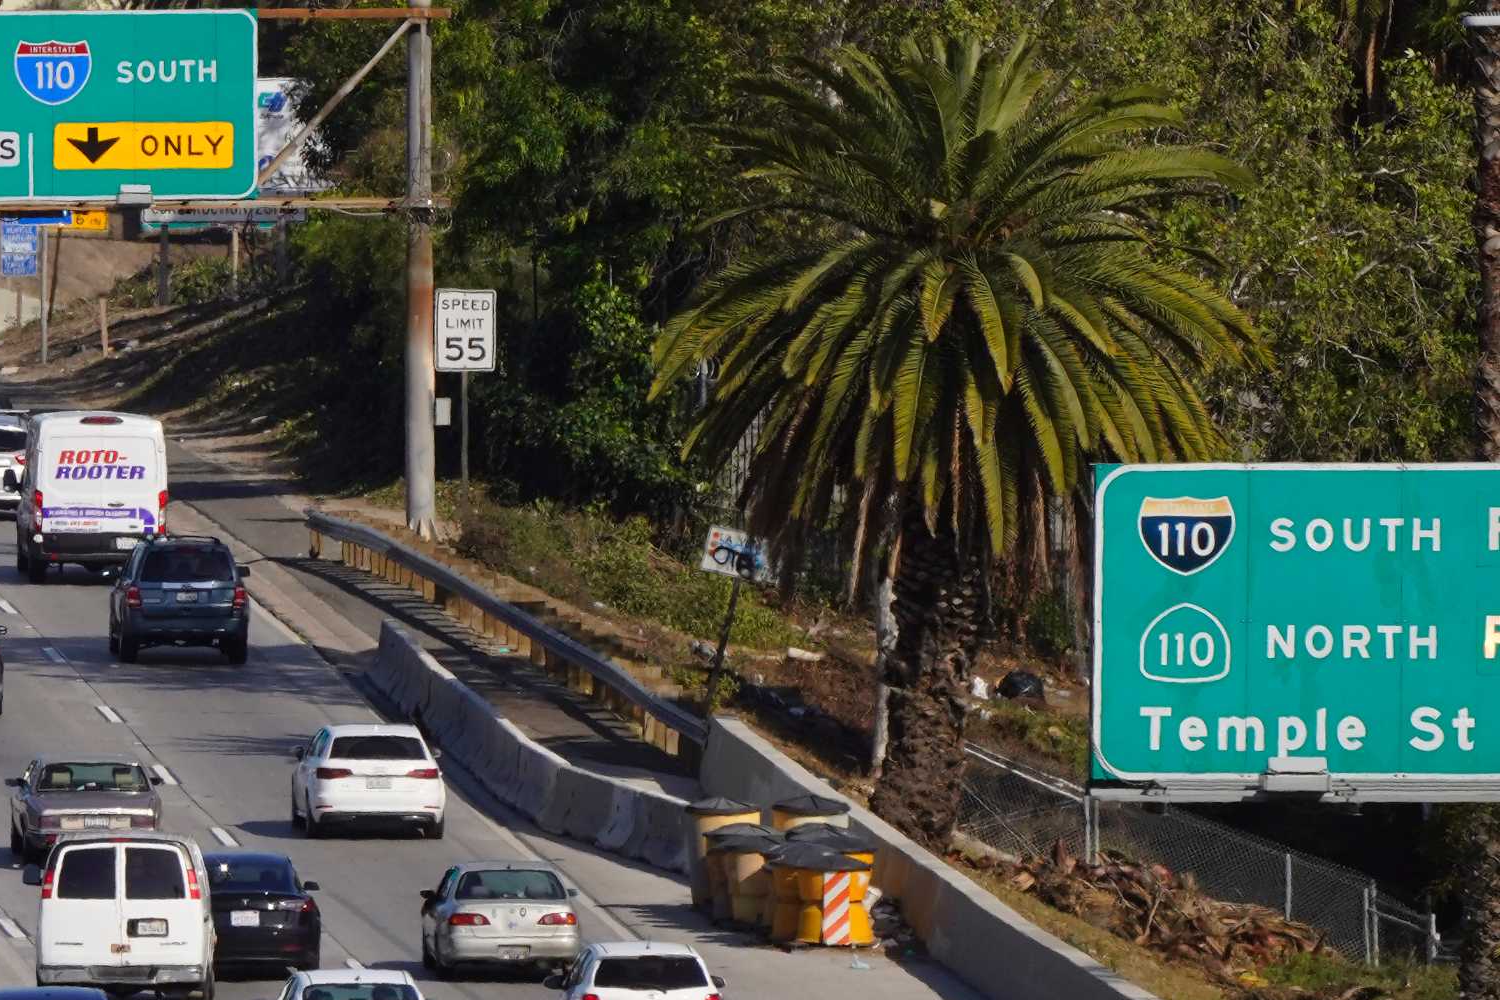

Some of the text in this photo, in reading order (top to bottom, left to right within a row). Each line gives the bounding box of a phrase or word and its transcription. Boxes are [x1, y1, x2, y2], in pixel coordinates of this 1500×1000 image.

[35, 60, 217, 89] 110 SOUTH
[141, 134, 225, 157] ONLY
[441, 299, 490, 311] SPEED
[445, 318, 484, 329] LIMIT
[445, 337, 486, 361] 55
[59, 449, 128, 465] ROTO-
[55, 465, 146, 480] ROOTER
[1158, 517, 1441, 557] 110 SOUTH
[1158, 624, 1438, 666] 110 NORTH
[1139, 706, 1476, 757] Temple St
